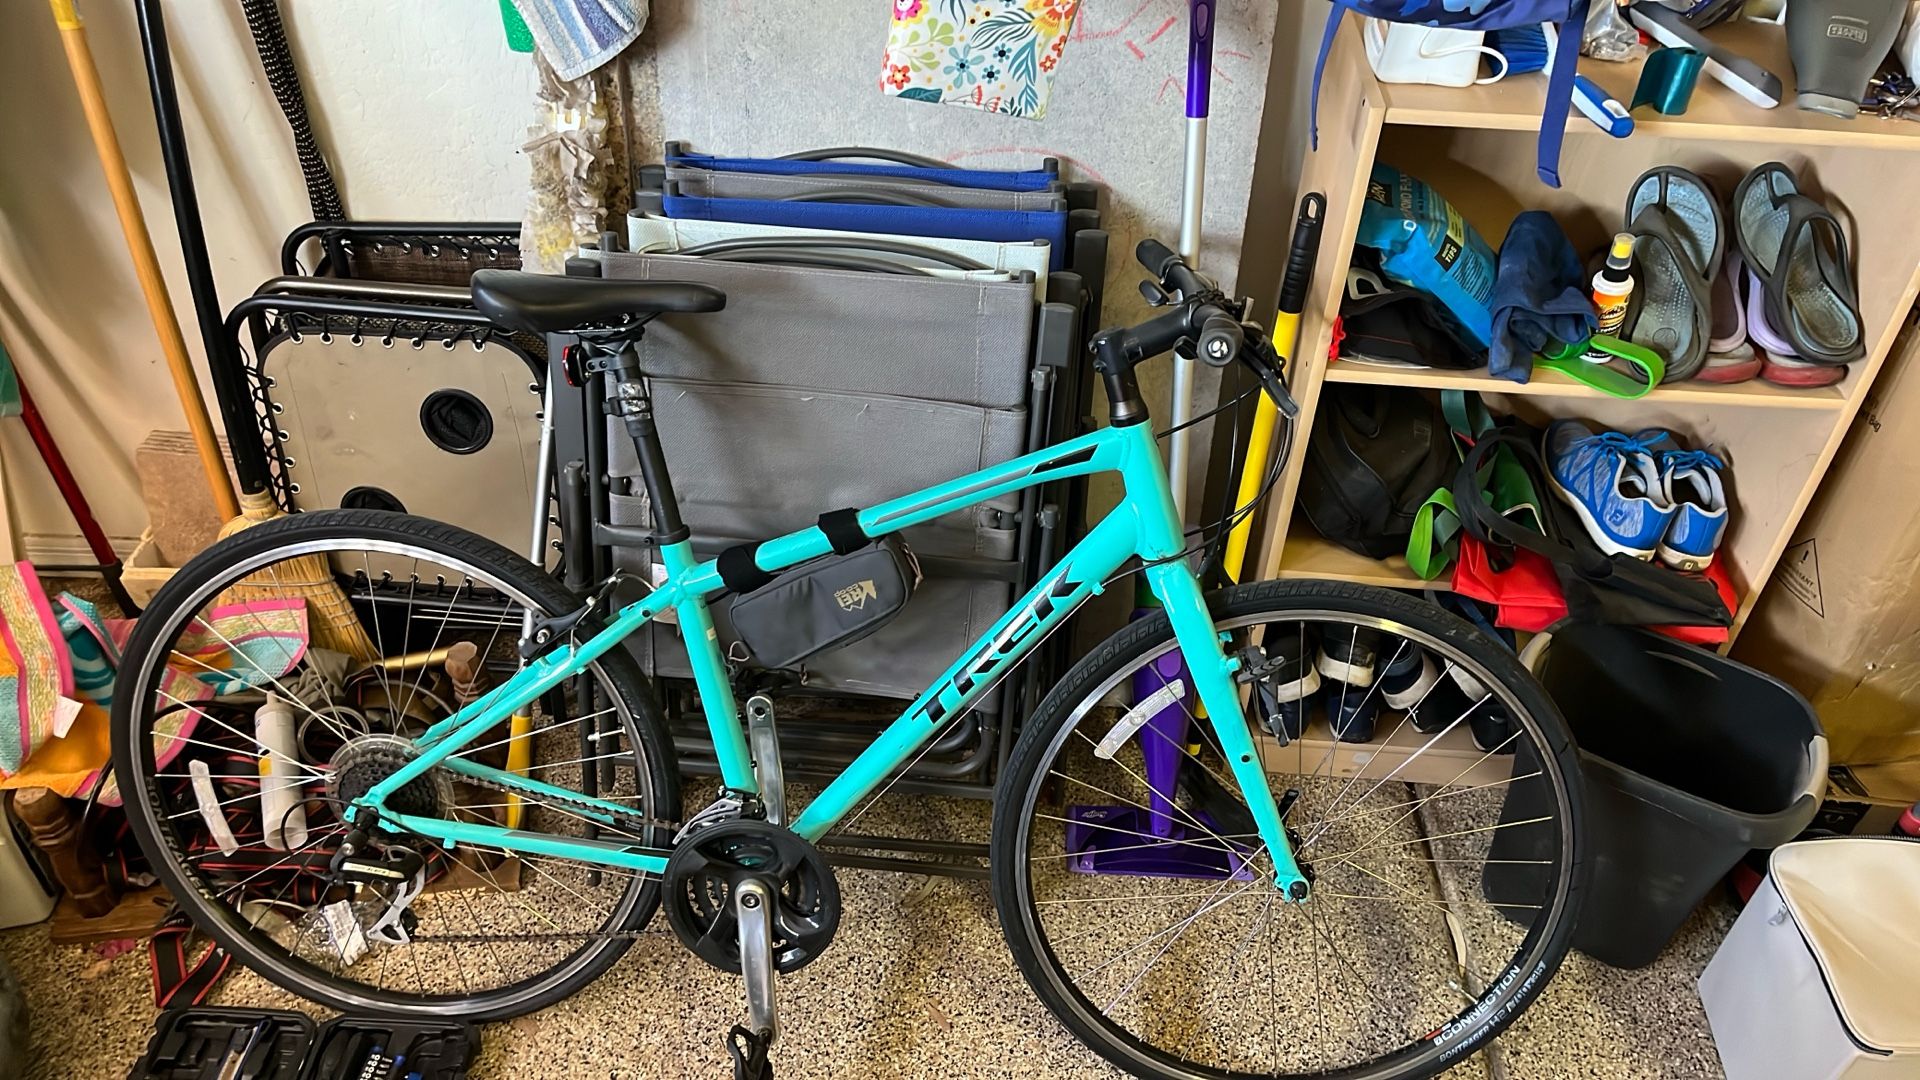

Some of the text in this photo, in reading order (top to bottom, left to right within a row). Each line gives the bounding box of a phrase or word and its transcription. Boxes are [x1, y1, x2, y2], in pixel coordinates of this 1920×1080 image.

[1445, 246, 1458, 263] TIPS
[836, 587, 863, 608] REI
[911, 560, 1085, 725] TREK
[146, 776, 215, 900] BONTRAGER
[1440, 964, 1521, 1041] CONNECTION
[1440, 1025, 1490, 1062] BONTRAGER
